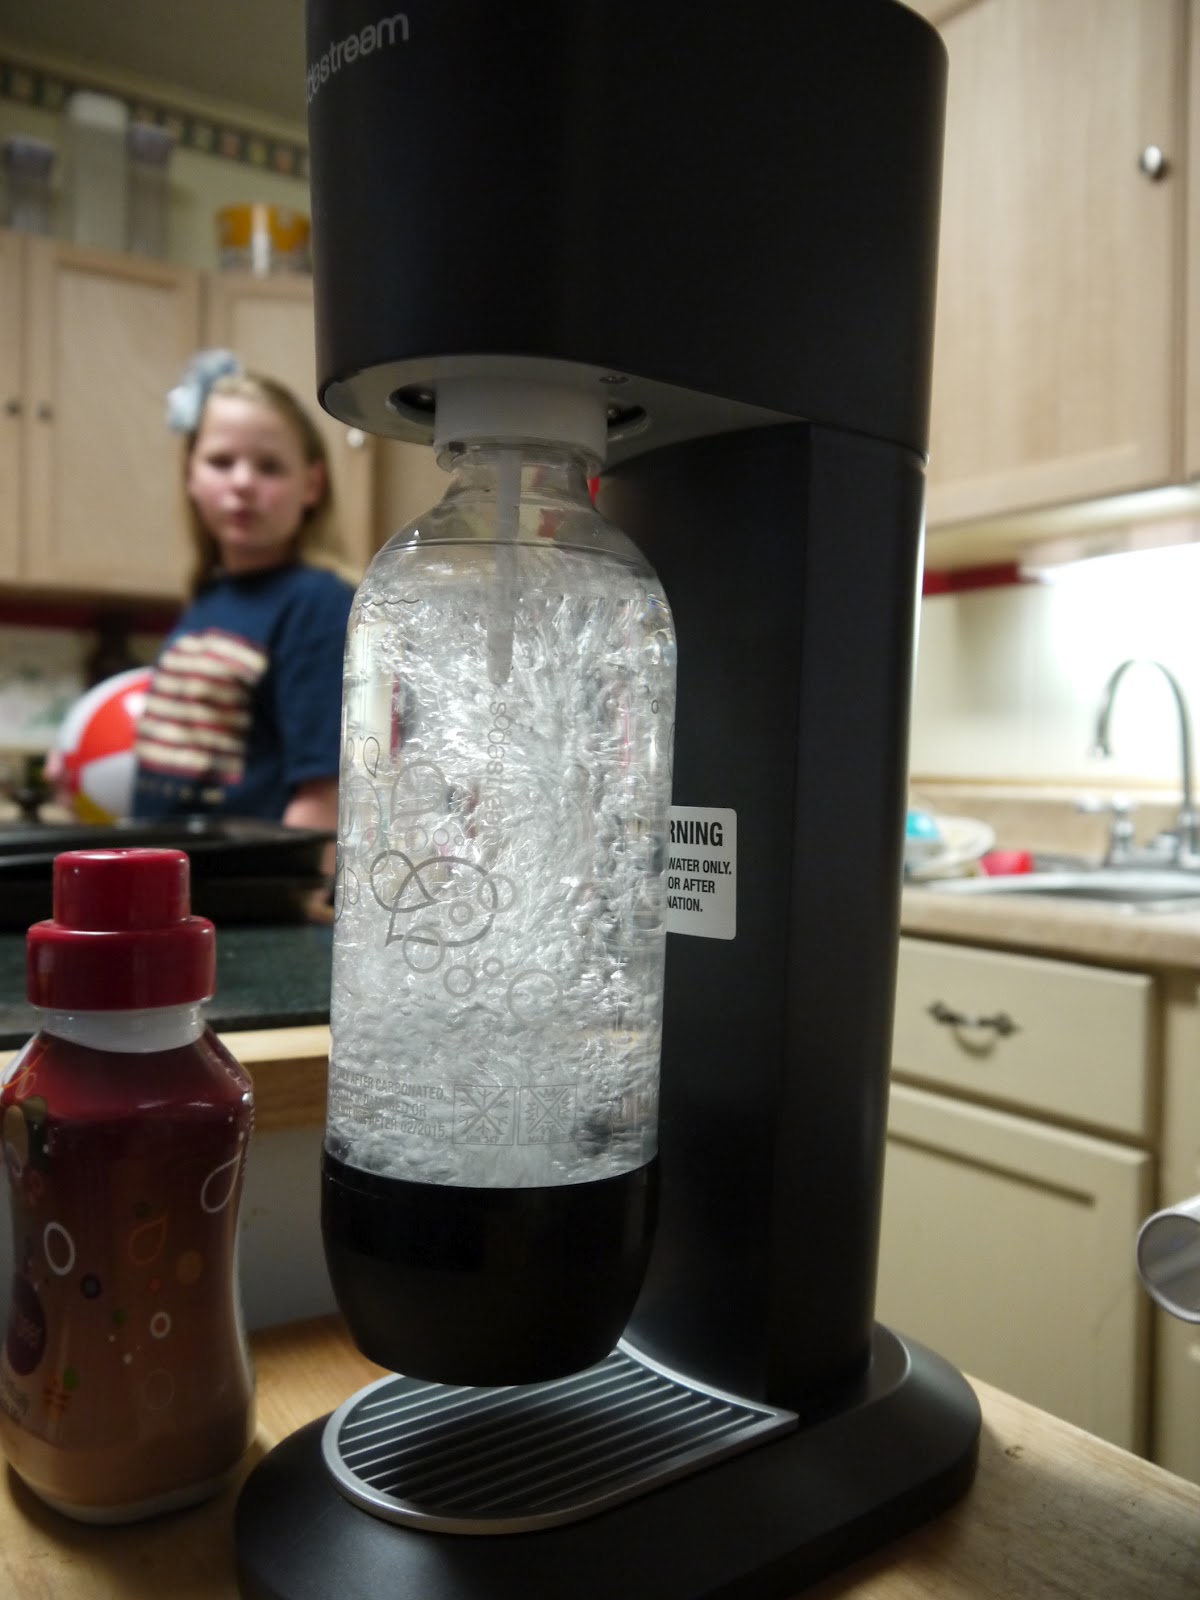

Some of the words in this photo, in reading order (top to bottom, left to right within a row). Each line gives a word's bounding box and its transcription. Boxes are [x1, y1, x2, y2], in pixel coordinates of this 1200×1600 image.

[702, 860, 732, 875] ONLY.
[668, 876, 680, 890] OR
[682, 878, 715, 894] AFTER
[376, 1079, 446, 1100] CARBONATED.
[412, 1103, 426, 1117] OR
